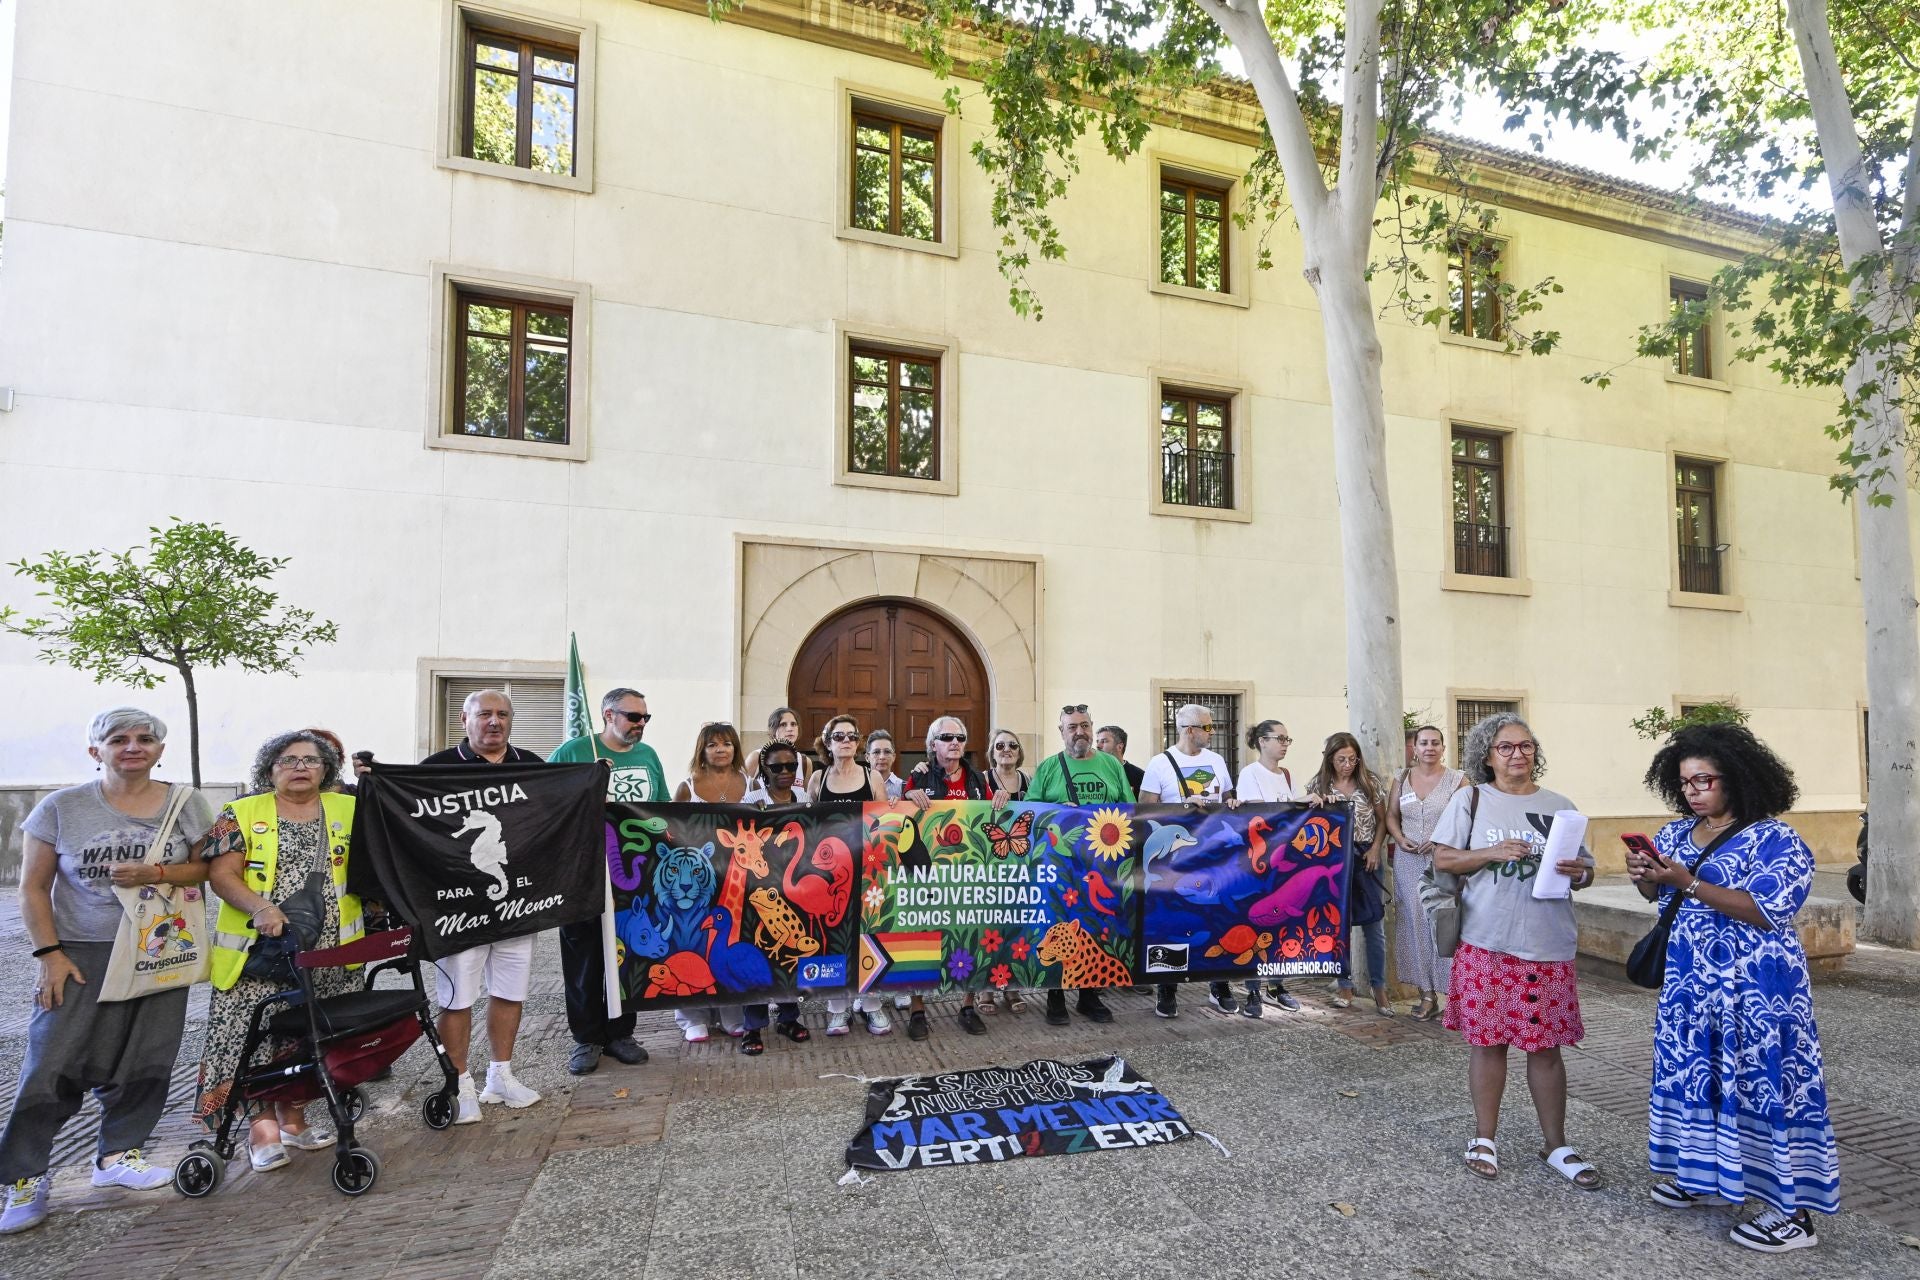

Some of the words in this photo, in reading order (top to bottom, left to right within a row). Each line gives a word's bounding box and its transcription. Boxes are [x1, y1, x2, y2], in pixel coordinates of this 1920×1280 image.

[410, 783, 528, 818] JUSTICIA
[1486, 828, 1504, 842] SI
[1509, 829, 1546, 845] NOS
[83, 843, 173, 864] WANDR
[887, 865, 908, 885] LA
[913, 864, 1030, 884] NATURALEZA
[1036, 864, 1057, 883] ES
[437, 887, 474, 900] PARA
[516, 876, 532, 888] EL
[896, 886, 1047, 907] BIODIVERSIDAD.
[434, 912, 490, 937] Mar
[494, 894, 564, 921] Menor
[897, 911, 951, 927] SOMOS
[956, 909, 1051, 925] NATURALEZA.
[135, 952, 198, 972] Chrysallis
[1257, 961, 1342, 976] SOSMARMENOR.ORG
[911, 1079, 1075, 1116] NUESTRO
[870, 1112, 992, 1150] MAR
[997, 1093, 1180, 1135] MENOR
